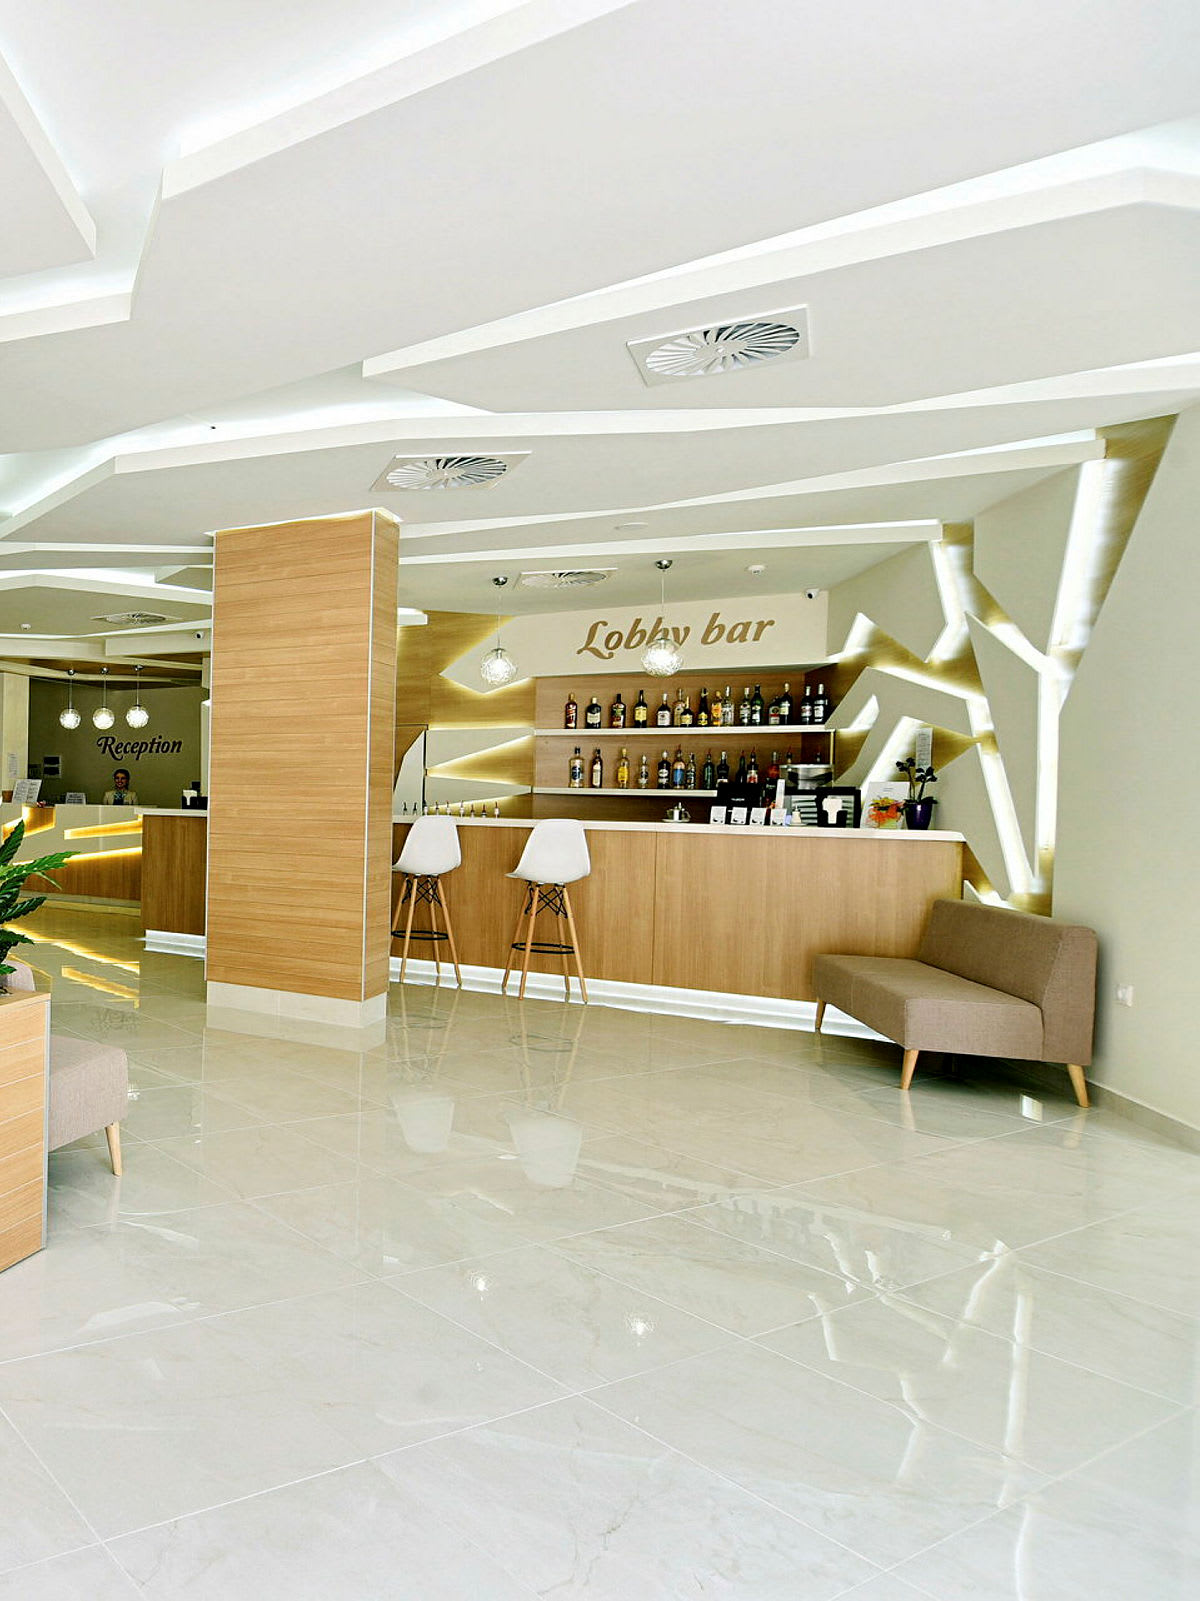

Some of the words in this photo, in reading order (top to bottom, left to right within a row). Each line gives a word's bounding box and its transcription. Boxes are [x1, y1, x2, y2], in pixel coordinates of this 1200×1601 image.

[576, 616, 691, 660] Lobby
[700, 612, 776, 645] bar
[96, 735, 183, 761] Reception
